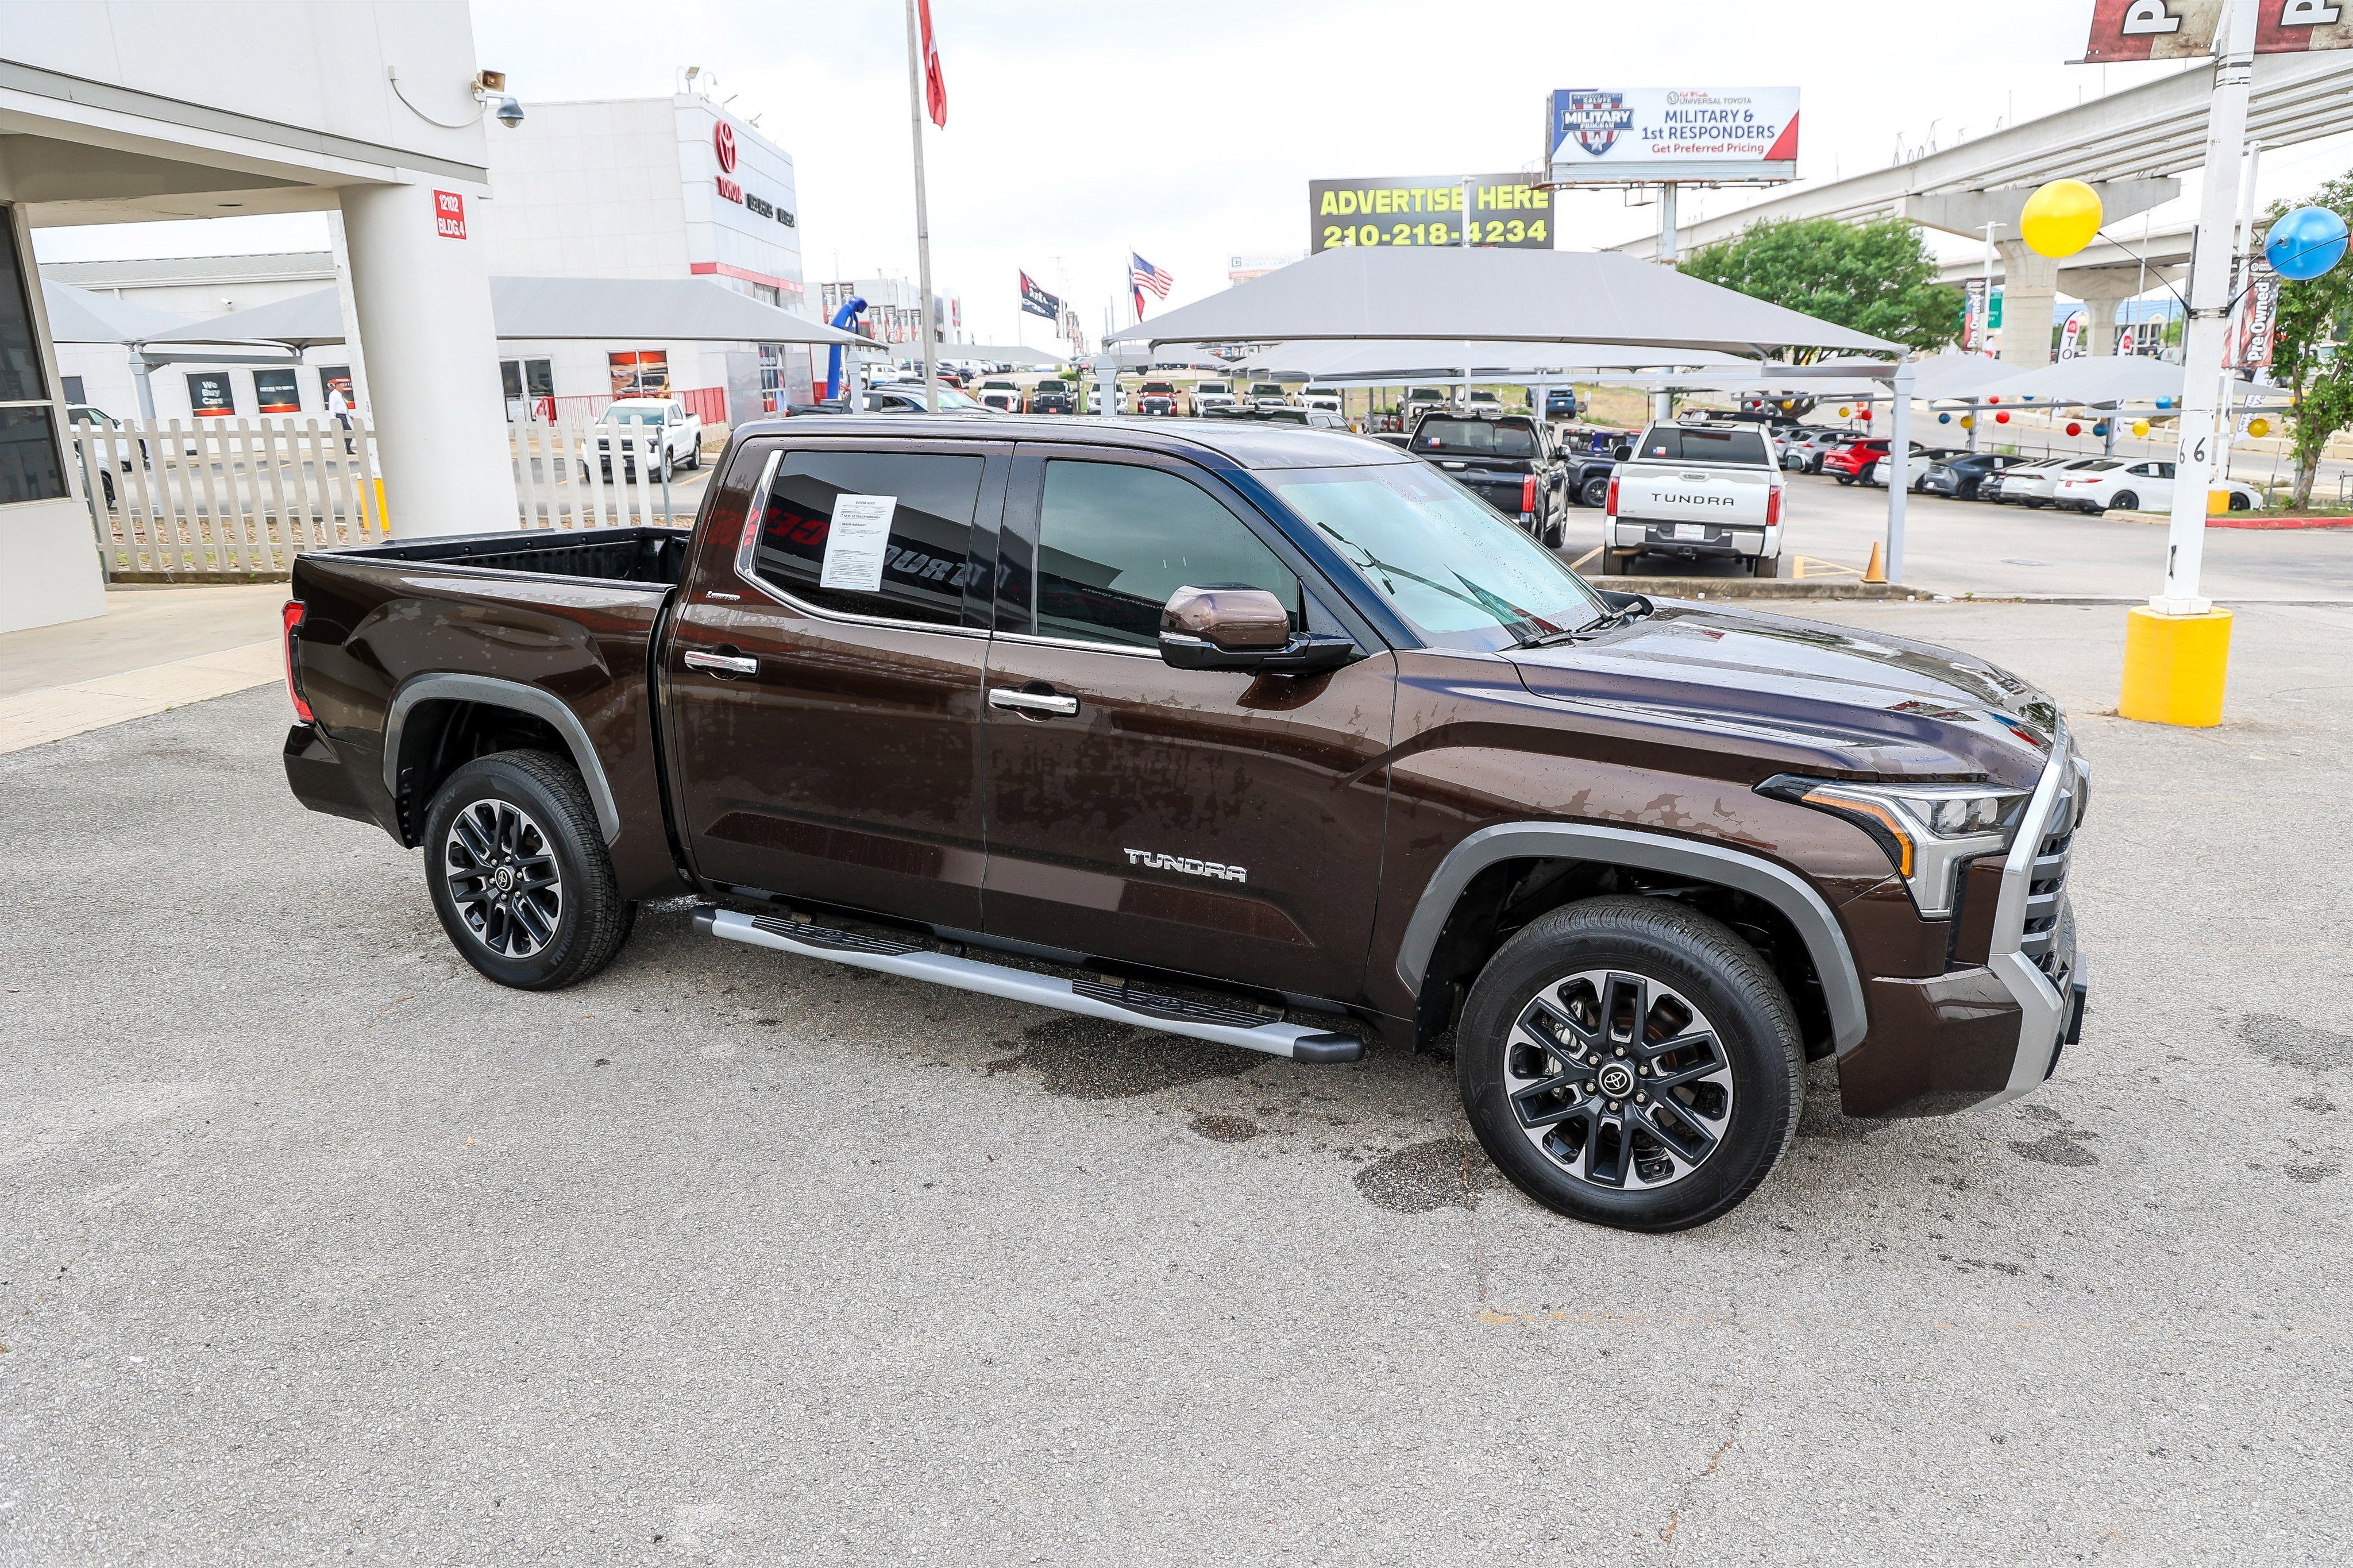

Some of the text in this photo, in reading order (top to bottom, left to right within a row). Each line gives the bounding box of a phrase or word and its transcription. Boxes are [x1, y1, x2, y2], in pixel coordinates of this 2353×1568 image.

[1564, 110, 1631, 125] MILITARY
[1665, 109, 1754, 123] MILITARY &
[1642, 125, 1775, 140] 1st RESPONDERS
[1652, 142, 1764, 154] Get Preferred Pricing
[716, 176, 743, 204] TOYOTA
[1320, 184, 1549, 215] ADVERTISE HERE
[438, 194, 460, 213] 12102
[1323, 219, 1547, 248] 210-218-4234
[1969, 294, 1981, 330] Owned
[2250, 281, 2270, 334] Owned
[1966, 330, 1979, 347] Pre
[2247, 335, 2264, 361] Pre
[201, 389, 221, 397] Buy
[202, 381, 218, 389] We
[202, 397, 224, 405] Cars
[2193, 437, 2206, 462] 6
[1651, 492, 1735, 506] TUNDRA
[1124, 848, 1248, 883] TUNDRA
[549, 907, 577, 966] YOKOHAMA
[1612, 937, 1712, 992] YOKOHAMA
